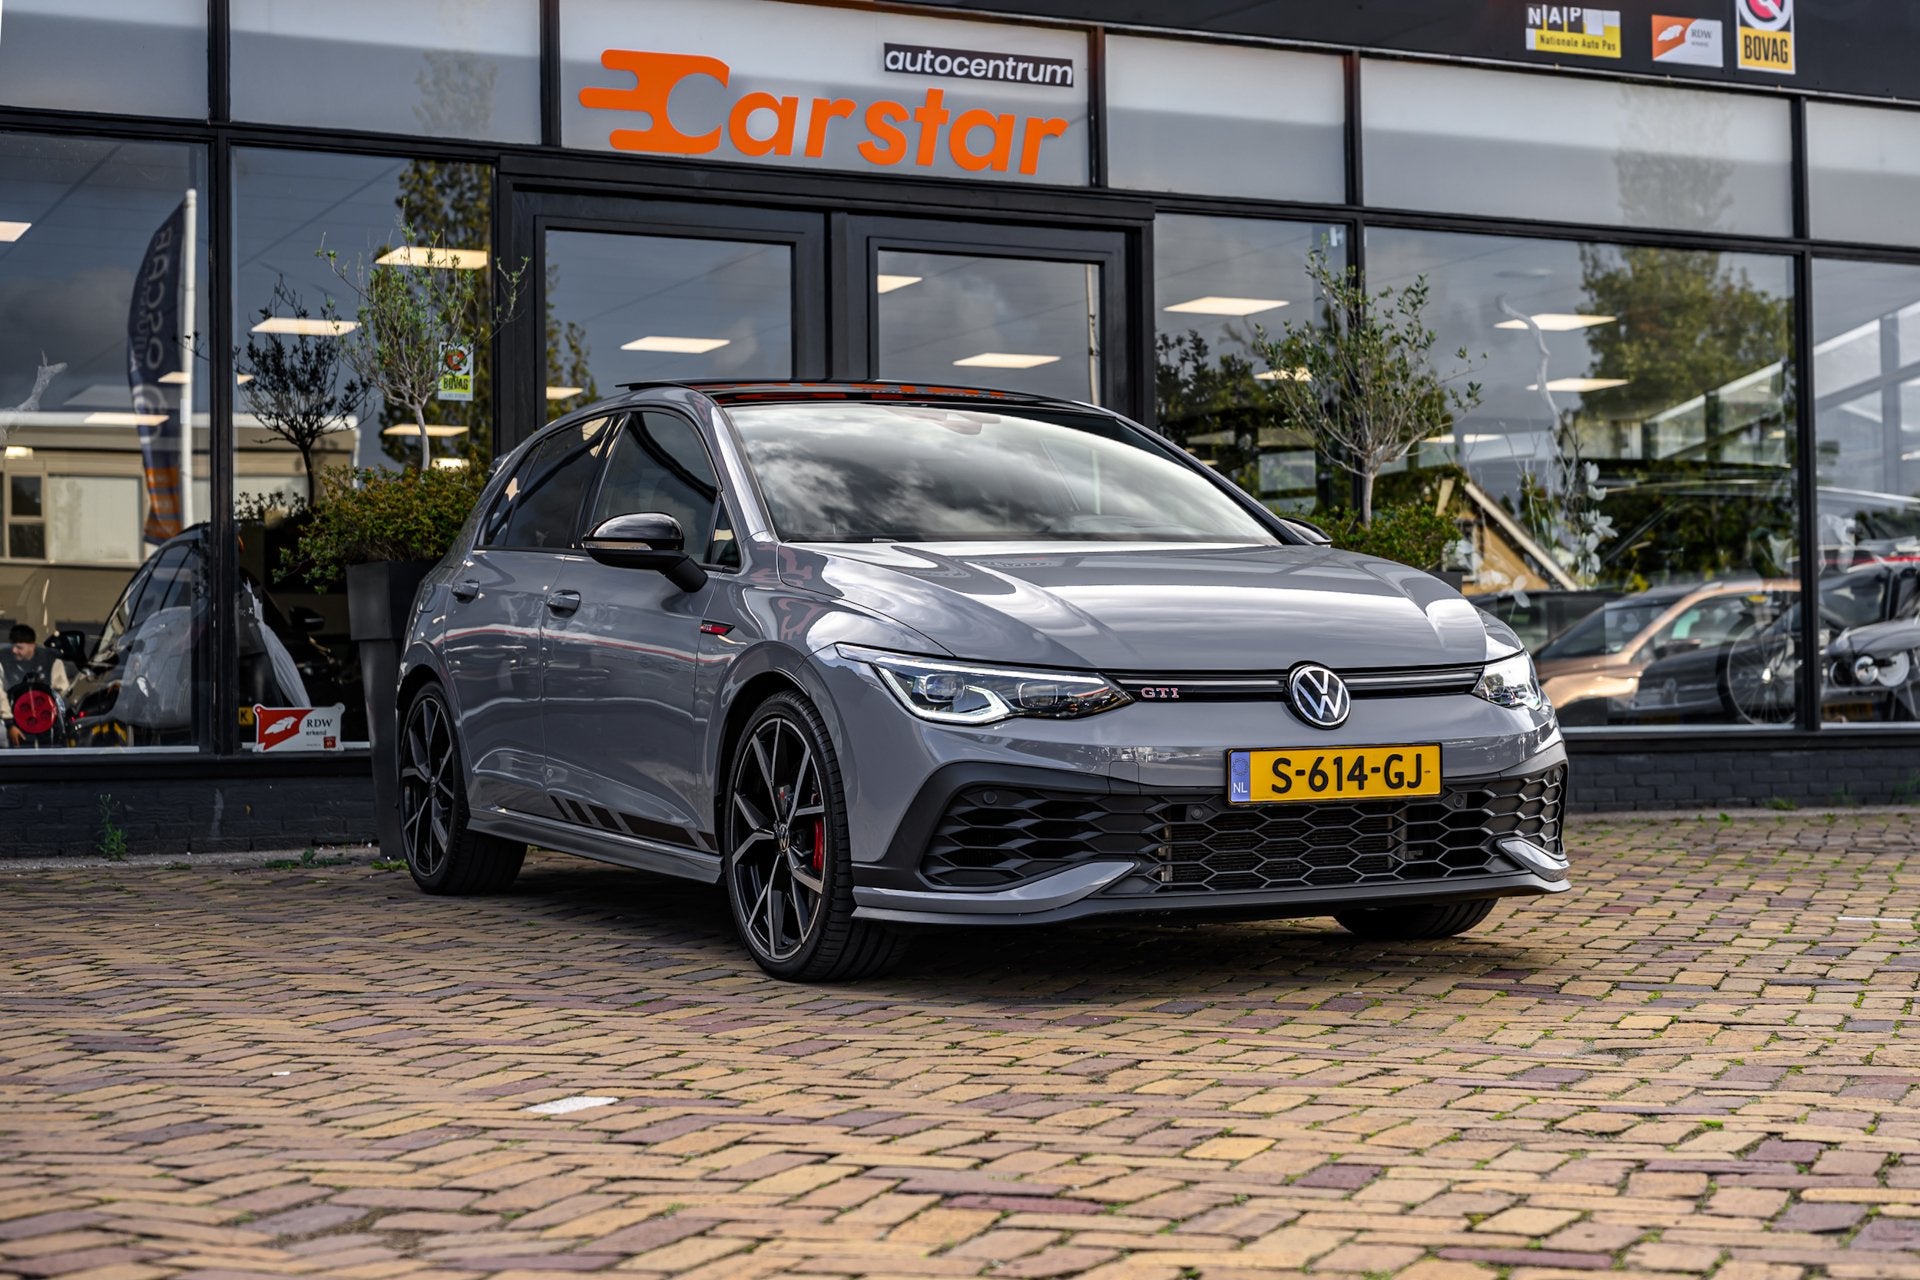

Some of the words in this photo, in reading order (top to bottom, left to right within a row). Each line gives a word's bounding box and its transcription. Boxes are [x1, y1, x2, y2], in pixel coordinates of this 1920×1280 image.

[1690, 28, 1713, 39] RDW
[1540, 35, 1579, 48] Nationale
[1581, 38, 1600, 50] Auto
[1601, 39, 1616, 51] Pas
[1743, 34, 1789, 64] BOVAG
[885, 47, 1073, 86] autocentrum
[578, 48, 1069, 176] Carstar
[1141, 686, 1180, 699] GTI
[306, 718, 334, 728] RDW
[1271, 752, 1423, 794] S-614-GJ
[1233, 782, 1248, 794] NL
